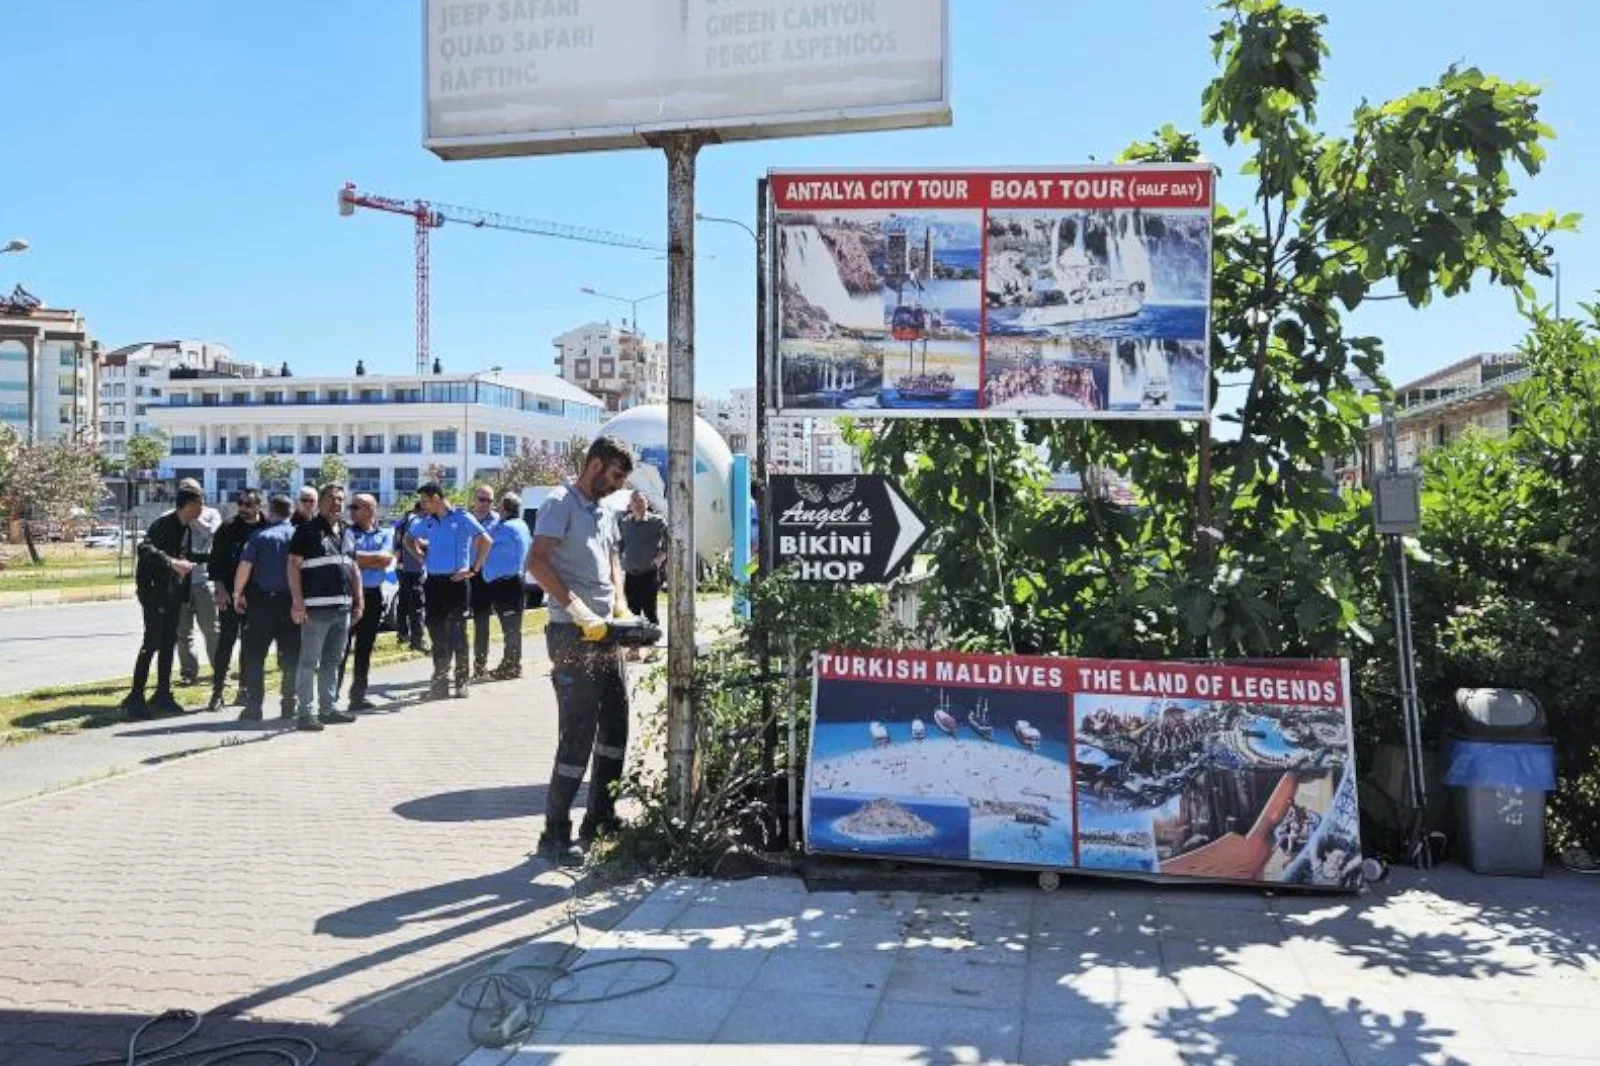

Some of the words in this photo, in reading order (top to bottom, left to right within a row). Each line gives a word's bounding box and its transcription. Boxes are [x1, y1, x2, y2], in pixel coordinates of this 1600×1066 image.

[437, 2, 490, 34] JEEP
[498, 0, 581, 22] SAFARI
[705, 10, 775, 38] GREEN
[783, 1, 875, 30] CANYON
[440, 33, 504, 64] QUAD
[513, 25, 594, 52] SAFARI
[781, 29, 898, 61] ASPENDOS
[785, 180, 866, 201] ANTALYA
[871, 180, 913, 200] CITY
[918, 179, 969, 199] TOUR
[990, 179, 1053, 200] BOAT
[1059, 178, 1125, 199] TOUR
[1128, 177, 1168, 201] (HALF
[1171, 177, 1203, 201] DAY)
[779, 500, 873, 529] Angel's
[780, 530, 872, 555] BİKİNİ
[819, 653, 928, 680] TURKISH
[935, 661, 1064, 688] MALDİVES
[1079, 668, 1122, 691] THE
[1129, 670, 1187, 694] LAND
[1195, 675, 1224, 695] OF
[1231, 675, 1337, 702] LEGENDS
